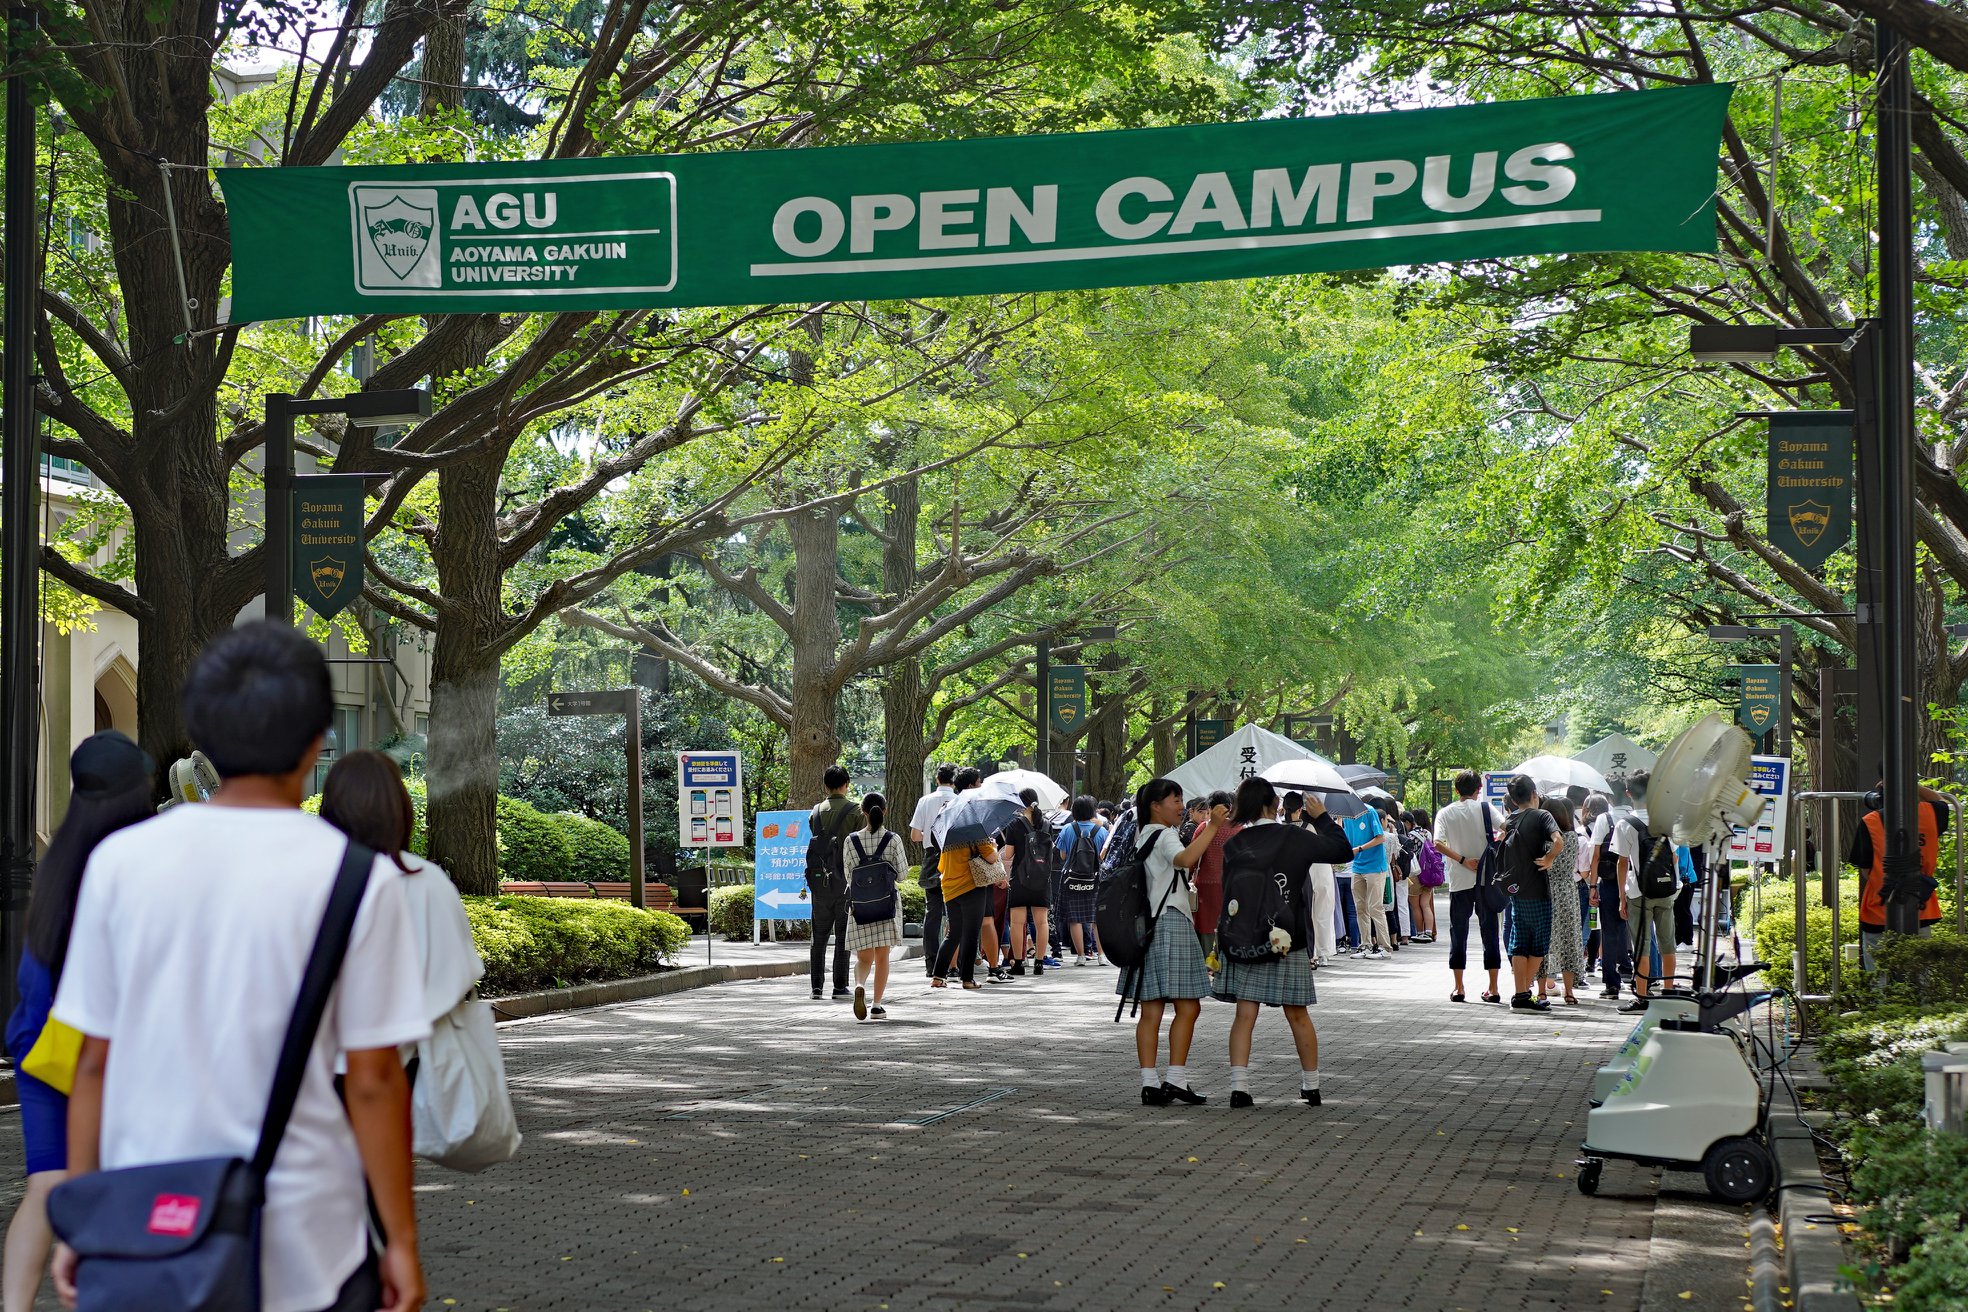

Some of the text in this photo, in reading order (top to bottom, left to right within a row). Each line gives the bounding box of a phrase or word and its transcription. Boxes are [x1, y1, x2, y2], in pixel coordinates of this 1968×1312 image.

[772, 142, 1577, 257] OPEN CAMPUS
[450, 192, 557, 230] AGU
[450, 242, 626, 263] AOYAMA GAKUIN
[451, 265, 579, 283] UNIVERSITY
[1778, 440, 1828, 454] Aoyama
[1777, 458, 1825, 470] Gakuin
[1777, 475, 1844, 489] University
[301, 502, 343, 514] Aoyama
[301, 518, 341, 529] Gakuin
[301, 533, 356, 545] University
[760, 845, 808, 855] 大きな手荷
[1069, 883, 1094, 891] adidas
